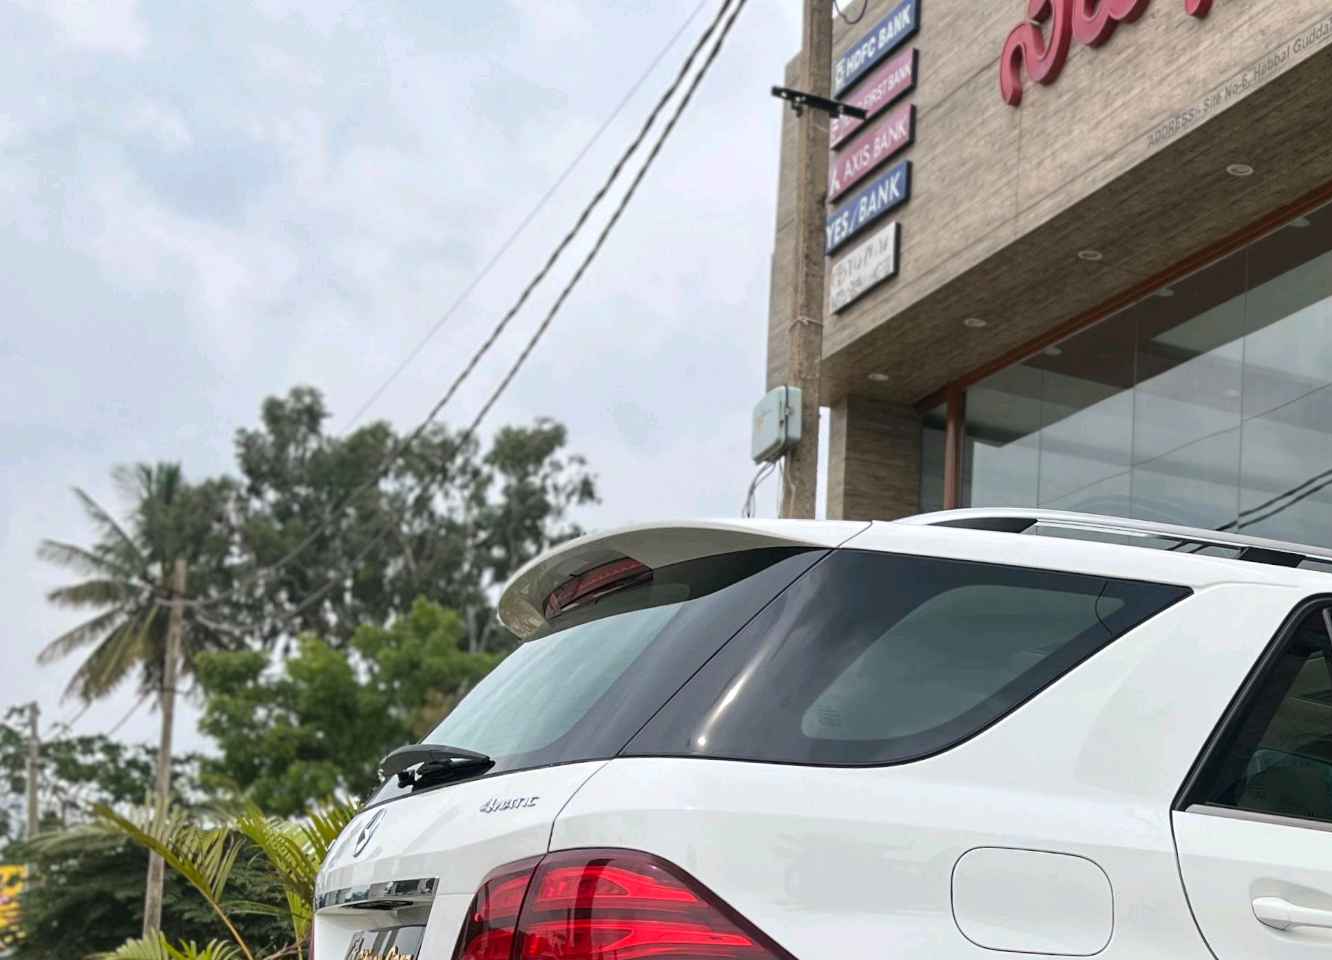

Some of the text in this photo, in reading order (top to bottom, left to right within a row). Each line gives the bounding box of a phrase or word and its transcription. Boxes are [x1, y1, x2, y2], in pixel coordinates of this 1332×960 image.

[846, 4, 911, 77] HDFC BANK
[843, 120, 907, 182] AXIS BANK
[825, 170, 900, 249] YES BANK
